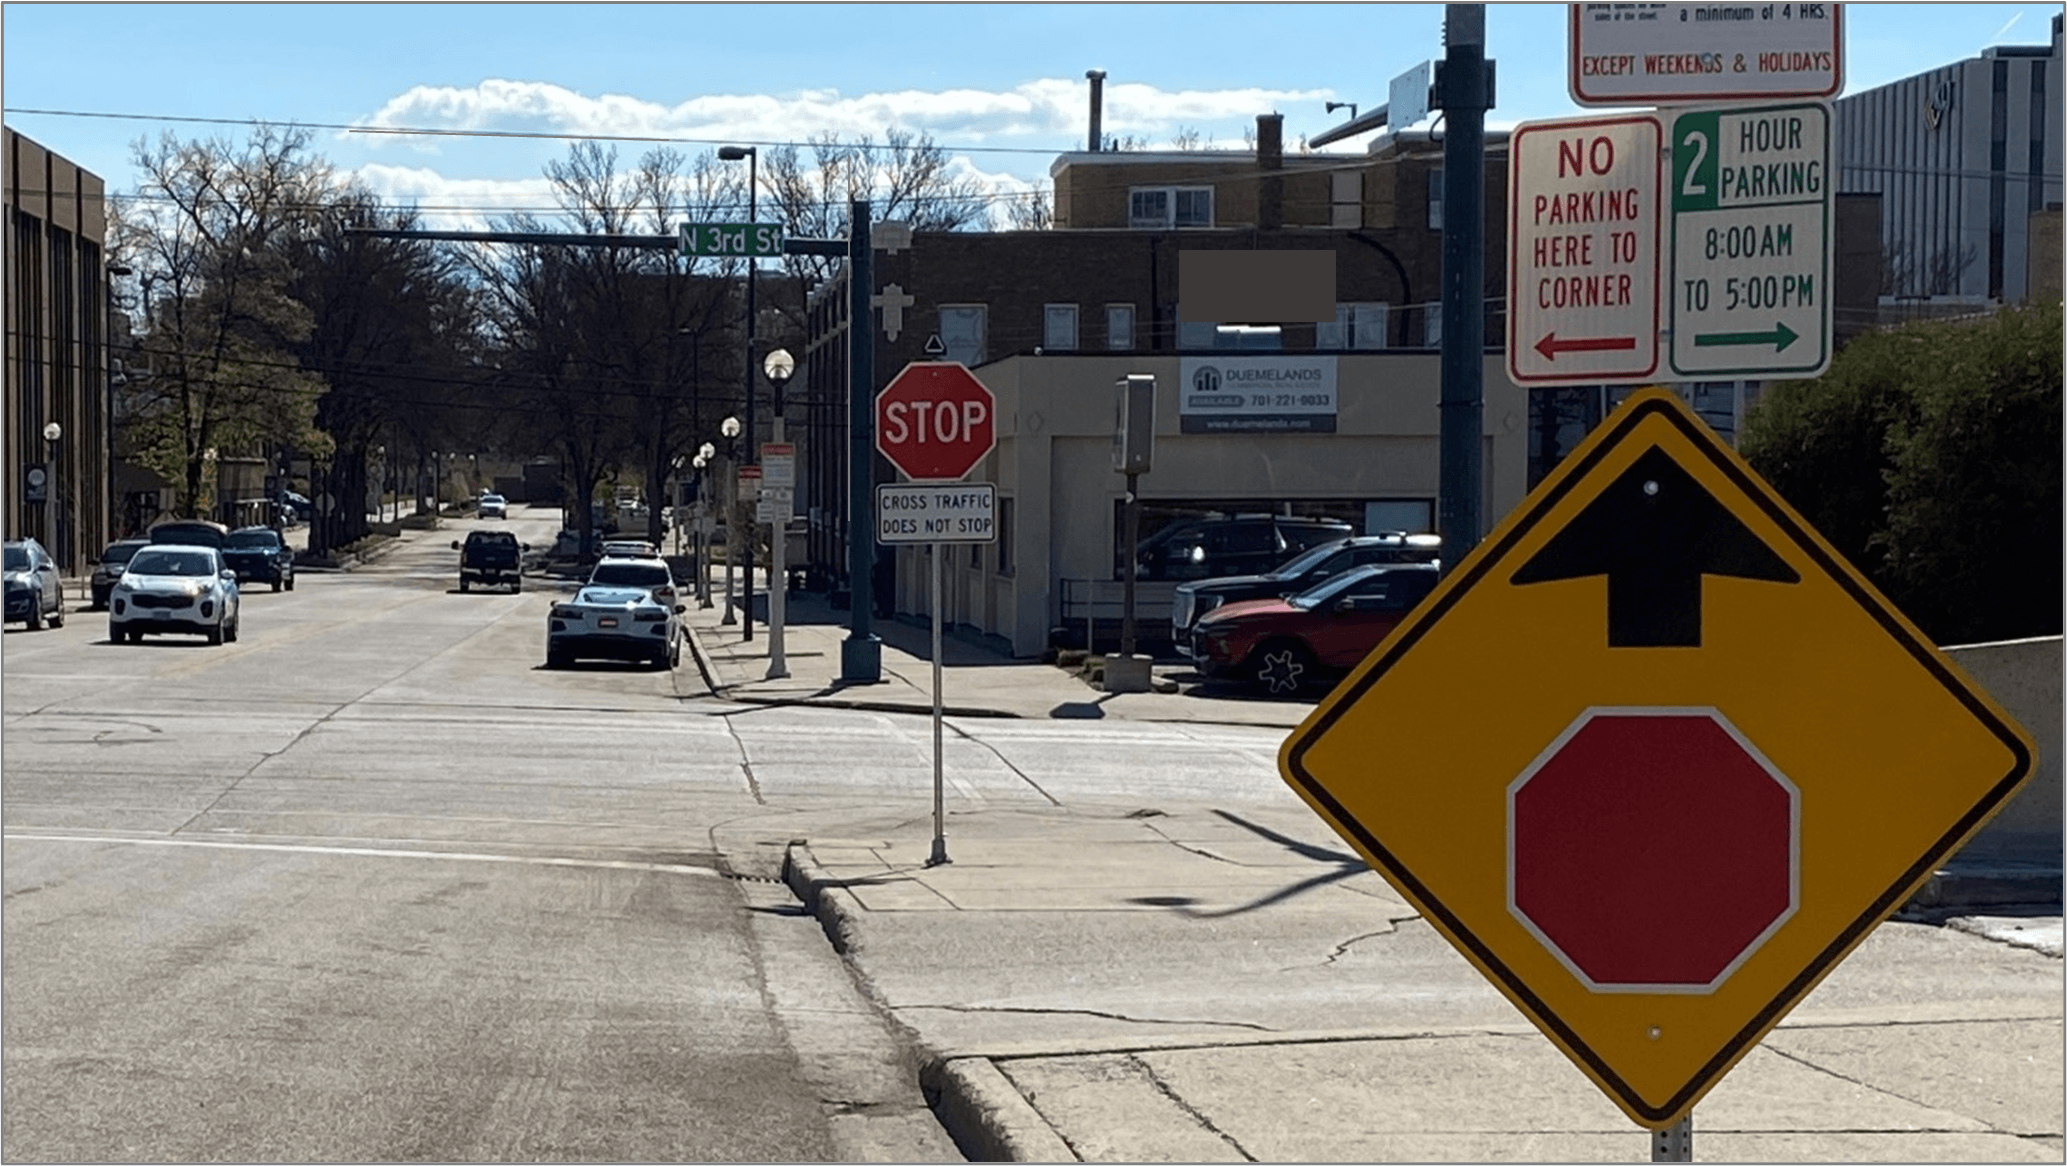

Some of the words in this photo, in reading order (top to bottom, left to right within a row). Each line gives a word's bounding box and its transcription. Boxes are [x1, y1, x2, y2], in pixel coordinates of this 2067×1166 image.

[1680, 8, 1688, 22] a
[1696, 4, 1754, 21] minimum
[1761, 4, 1774, 20] of
[1782, 4, 1792, 20] 4
[1583, 55, 1636, 76] EXCEPT
[1733, 53, 1747, 73] &
[1759, 52, 1832, 72] HOLIDAYS
[1740, 117, 1802, 153] HOUR
[1559, 136, 1614, 178] NO
[1682, 131, 1708, 195] 2
[1721, 160, 1820, 199] PARKING
[1534, 188, 1638, 226] PARKING
[681, 227, 698, 253] N
[707, 227, 746, 253] 3rd
[756, 228, 781, 253] St
[1534, 234, 1593, 268] HERE
[1611, 231, 1636, 264] TO
[1539, 274, 1632, 309] CORNER
[1684, 278, 1709, 312] TO
[1226, 368, 1323, 381] DUEMELANDS
[885, 401, 987, 443] STOP
[883, 495, 927, 510] CROSS
[935, 494, 991, 509] TRAFFIC
[883, 519, 917, 534] DOES
[925, 518, 950, 533] NOT
[958, 517, 992, 532] STOP
